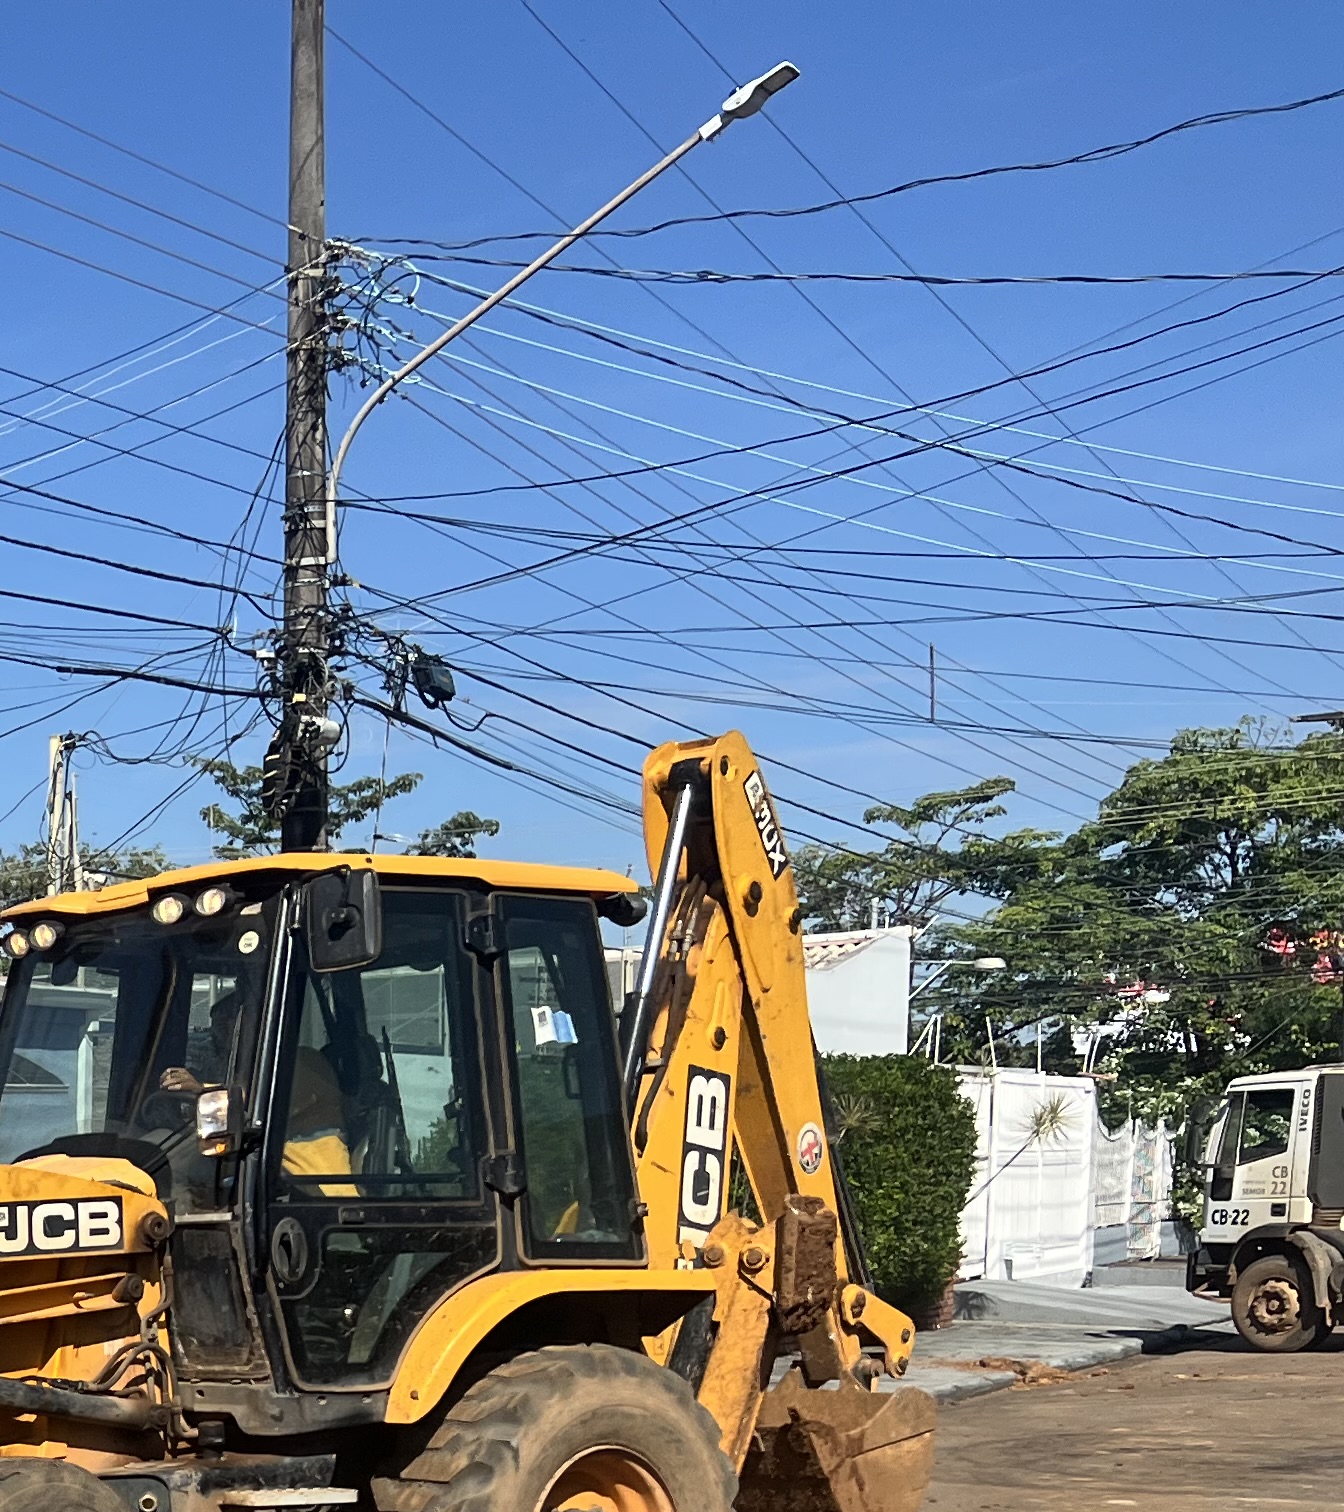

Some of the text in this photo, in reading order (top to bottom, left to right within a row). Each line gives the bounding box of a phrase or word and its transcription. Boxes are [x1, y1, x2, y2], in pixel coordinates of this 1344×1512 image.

[1299, 1089, 1311, 1132] IVECO
[1272, 1165, 1289, 1179] CB
[1270, 1181, 1287, 1195] 22
